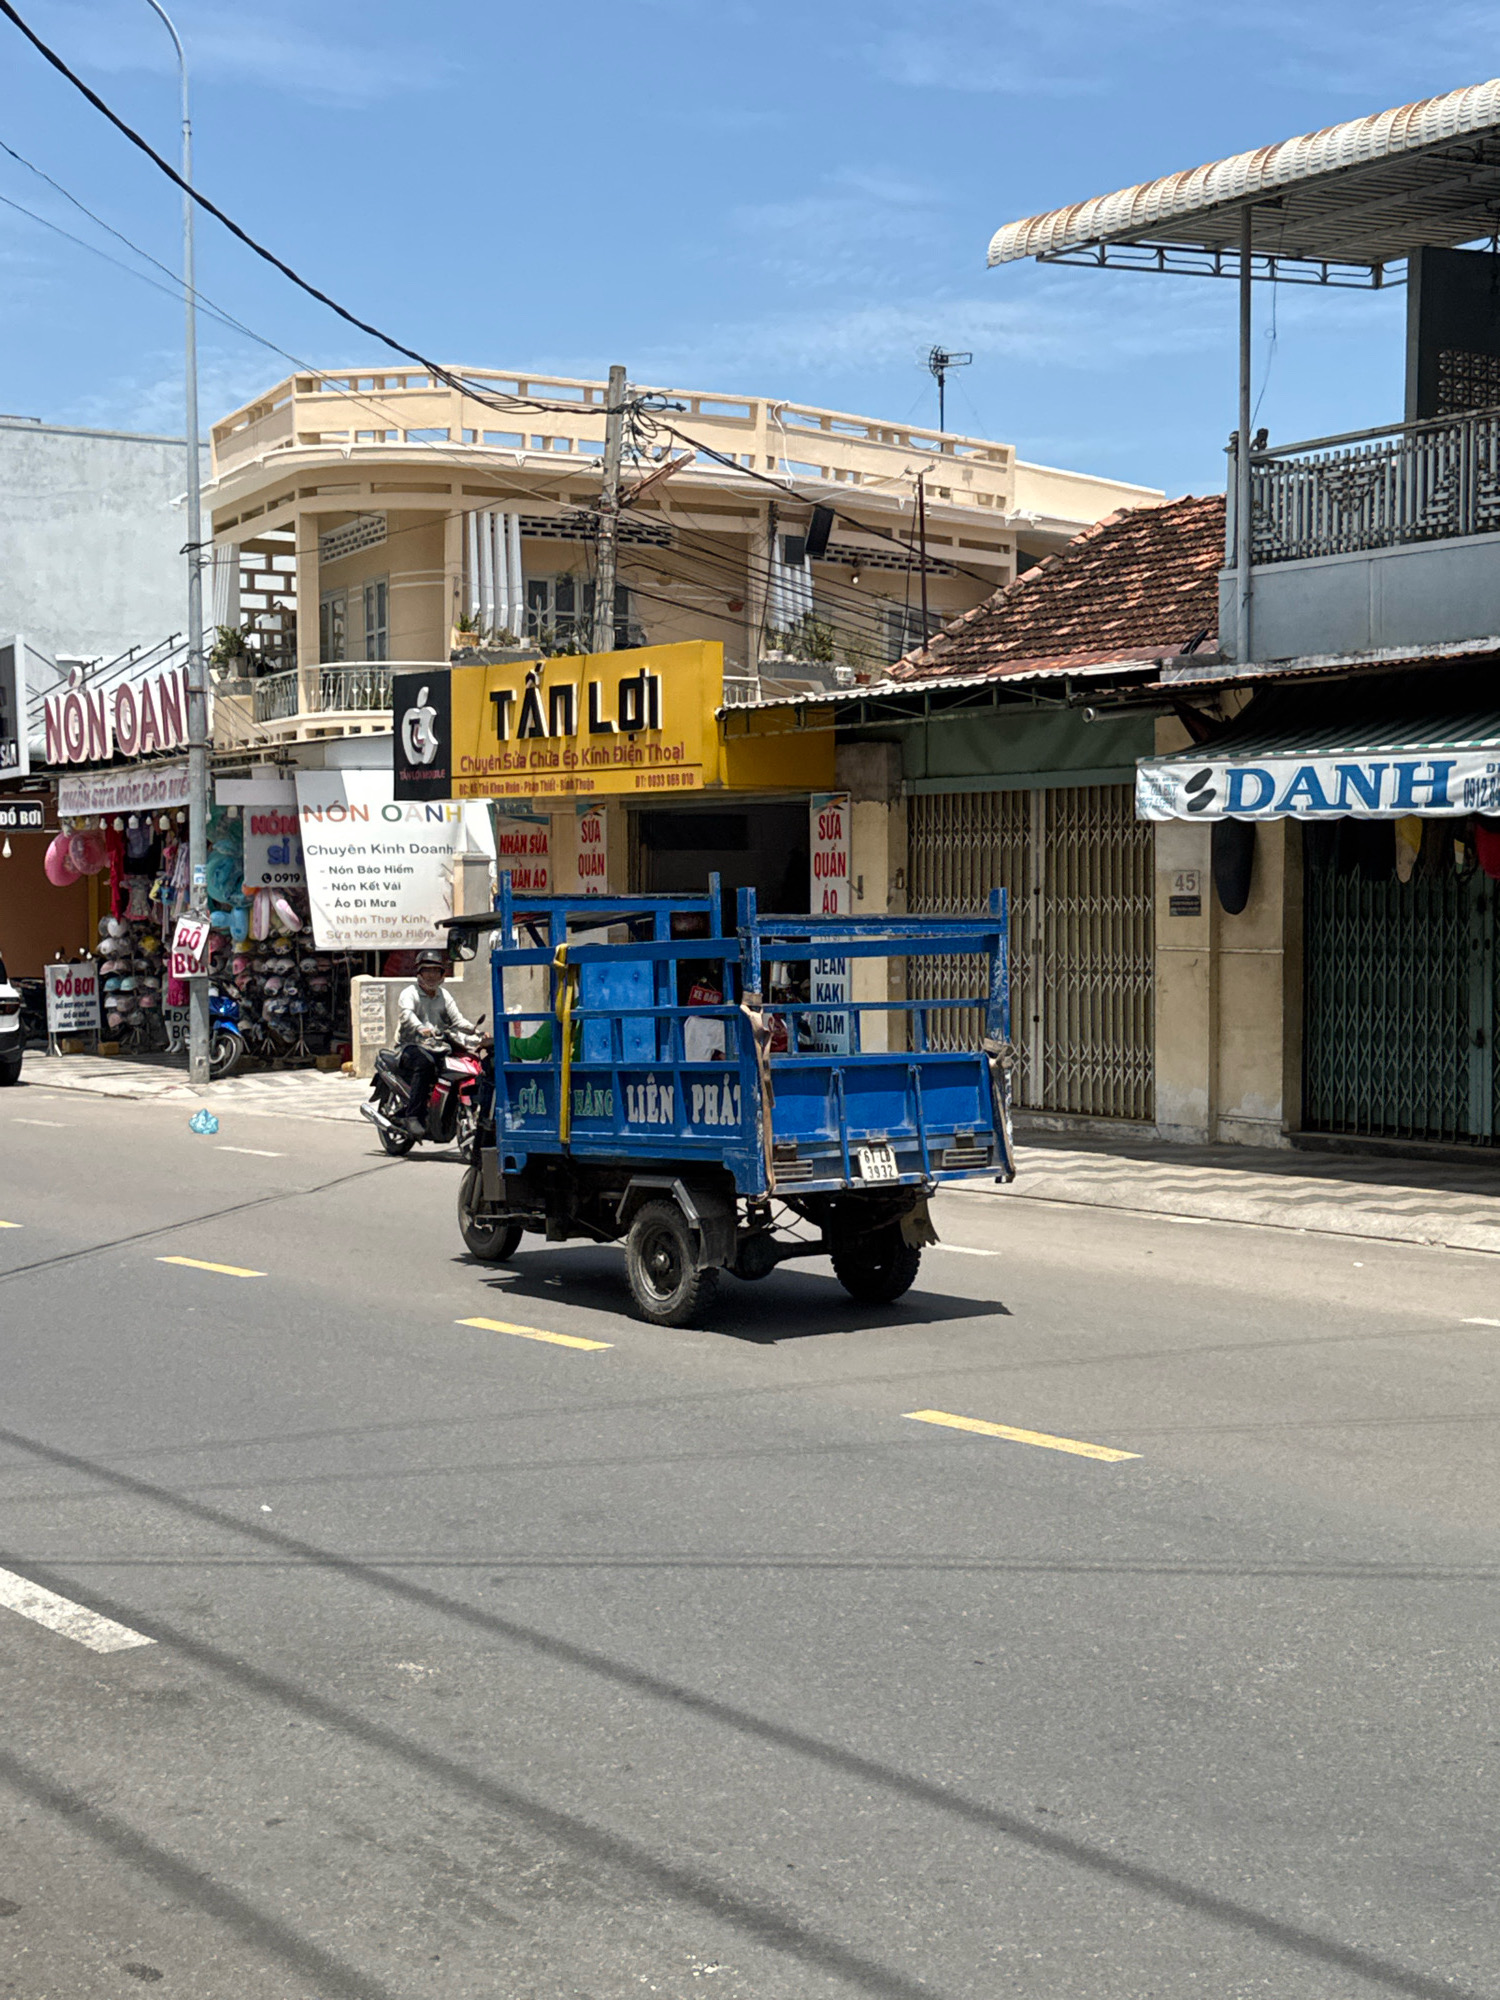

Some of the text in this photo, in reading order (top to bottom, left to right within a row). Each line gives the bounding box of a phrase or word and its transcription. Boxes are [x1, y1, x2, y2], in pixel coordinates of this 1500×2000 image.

[45, 666, 112, 765] NÓN
[460, 741, 685, 774] Chuyên Sửa Chữa Ép Kính Điện Thoại
[168, 770, 190, 800] HIỂ
[1221, 760, 1457, 813] DANH
[20, 809, 42, 825] BƠI
[303, 800, 462, 823] NÓN OANH
[251, 809, 299, 836] NÓN
[818, 805, 842, 840] SỬA
[306, 843, 367, 858] Chuyên
[371, 843, 406, 855] Kinh
[274, 873, 300, 884] 0919
[328, 862, 414, 875] Nón Bảo Hiểm
[511, 860, 547, 889] UẦN ÁO
[331, 879, 402, 892] Nón Kết Vải
[1174, 873, 1196, 891] 45
[334, 898, 397, 909] Áo Đi Mưa
[822, 883, 838, 914] ÁO
[336, 913, 367, 926] Nhận
[372, 913, 398, 927] Thay
[326, 928, 350, 941] Sửa
[354, 927, 378, 940] Nón
[381, 927, 403, 939] Bảo
[814, 957, 846, 976] JEAN
[74, 977, 95, 996] BƠI
[816, 983, 844, 1004] KAKI
[626, 1072, 674, 1125] LIÊN
